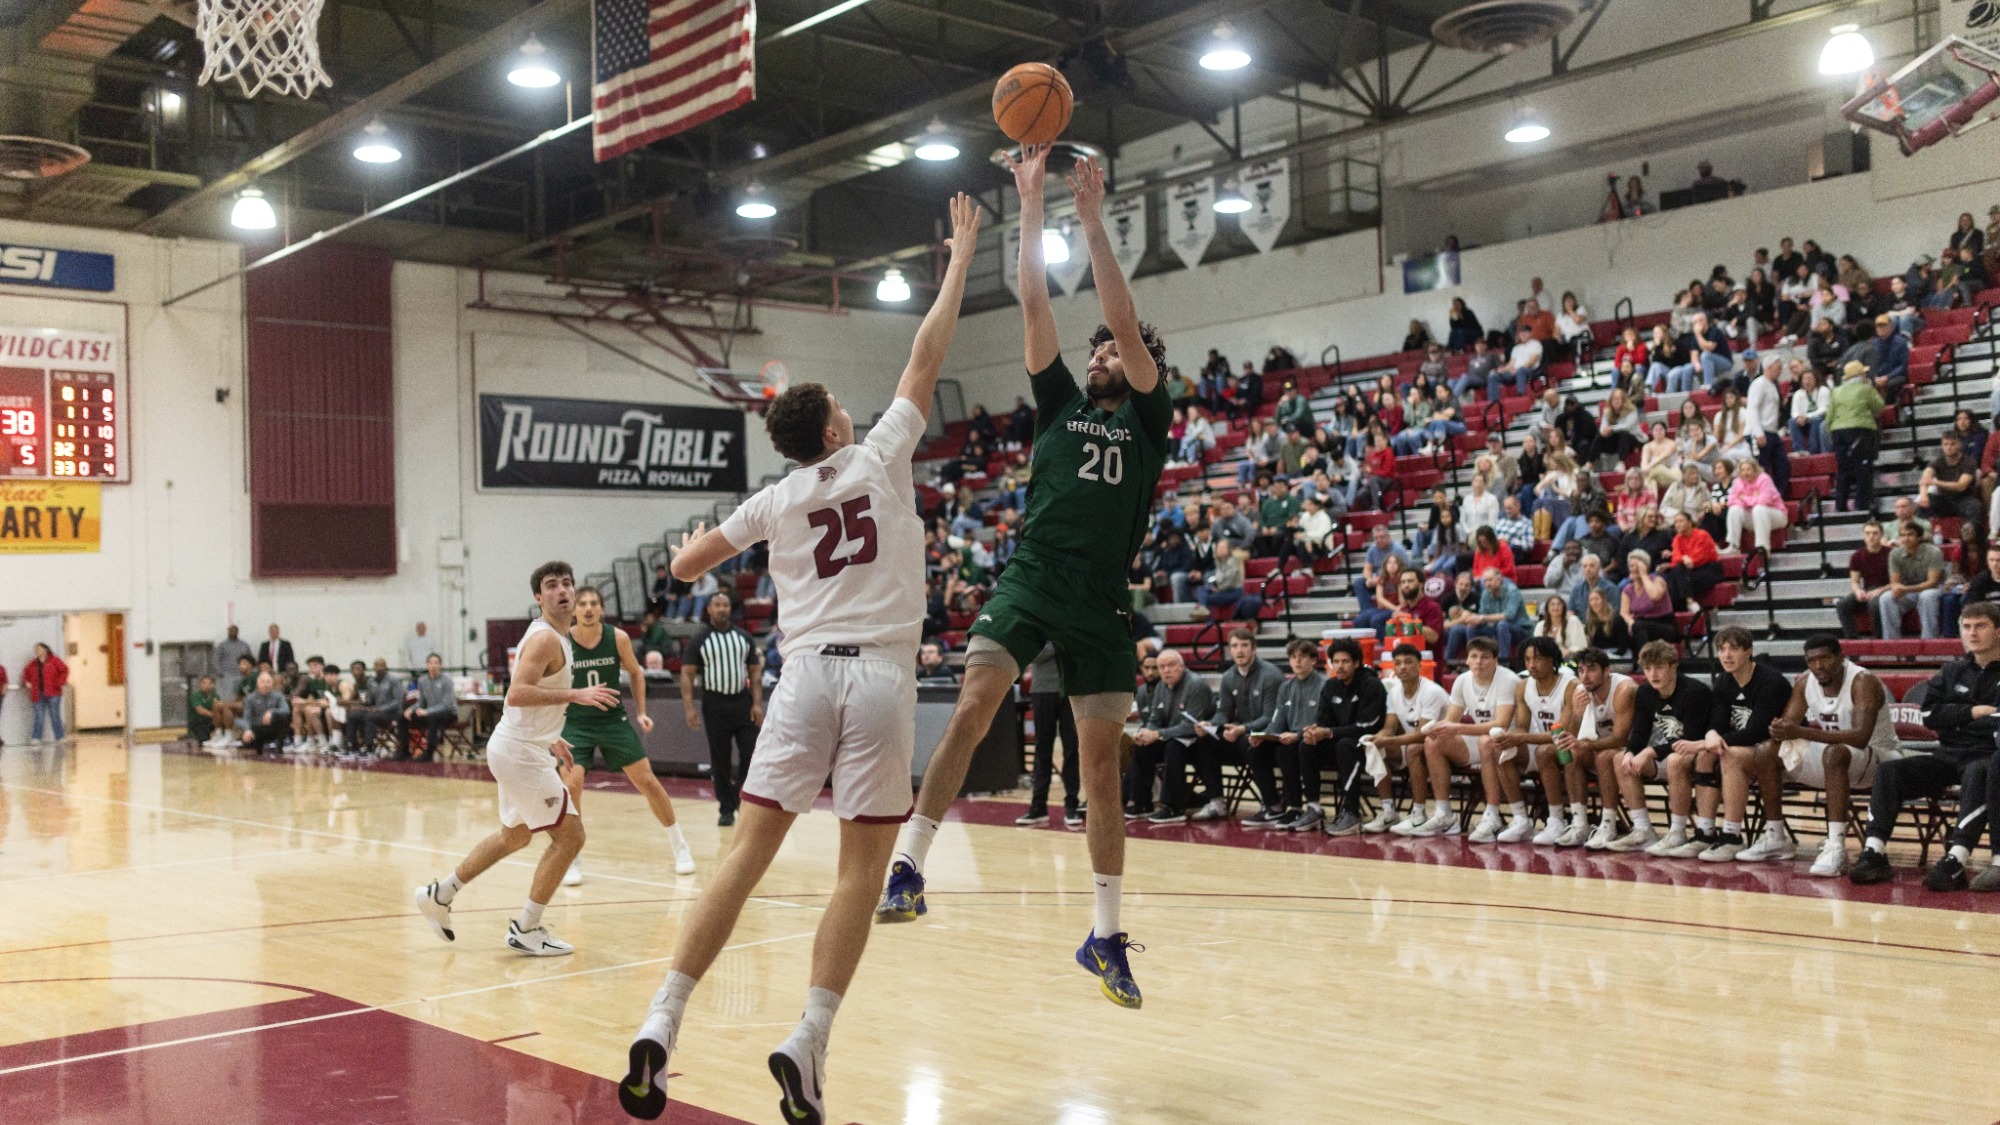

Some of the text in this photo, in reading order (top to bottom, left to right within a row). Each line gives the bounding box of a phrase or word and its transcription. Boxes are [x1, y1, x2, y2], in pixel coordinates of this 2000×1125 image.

[0, 246, 57, 281] SI
[2, 410, 35, 435] 38
[496, 402, 734, 473] ROUND TABLE
[20, 445, 35, 466] 5
[1078, 442, 1122, 485] 20
[599, 471, 712, 487] PIZZA ROYALTY
[807, 494, 877, 579] 25
[573, 656, 615, 669] RONCOS
